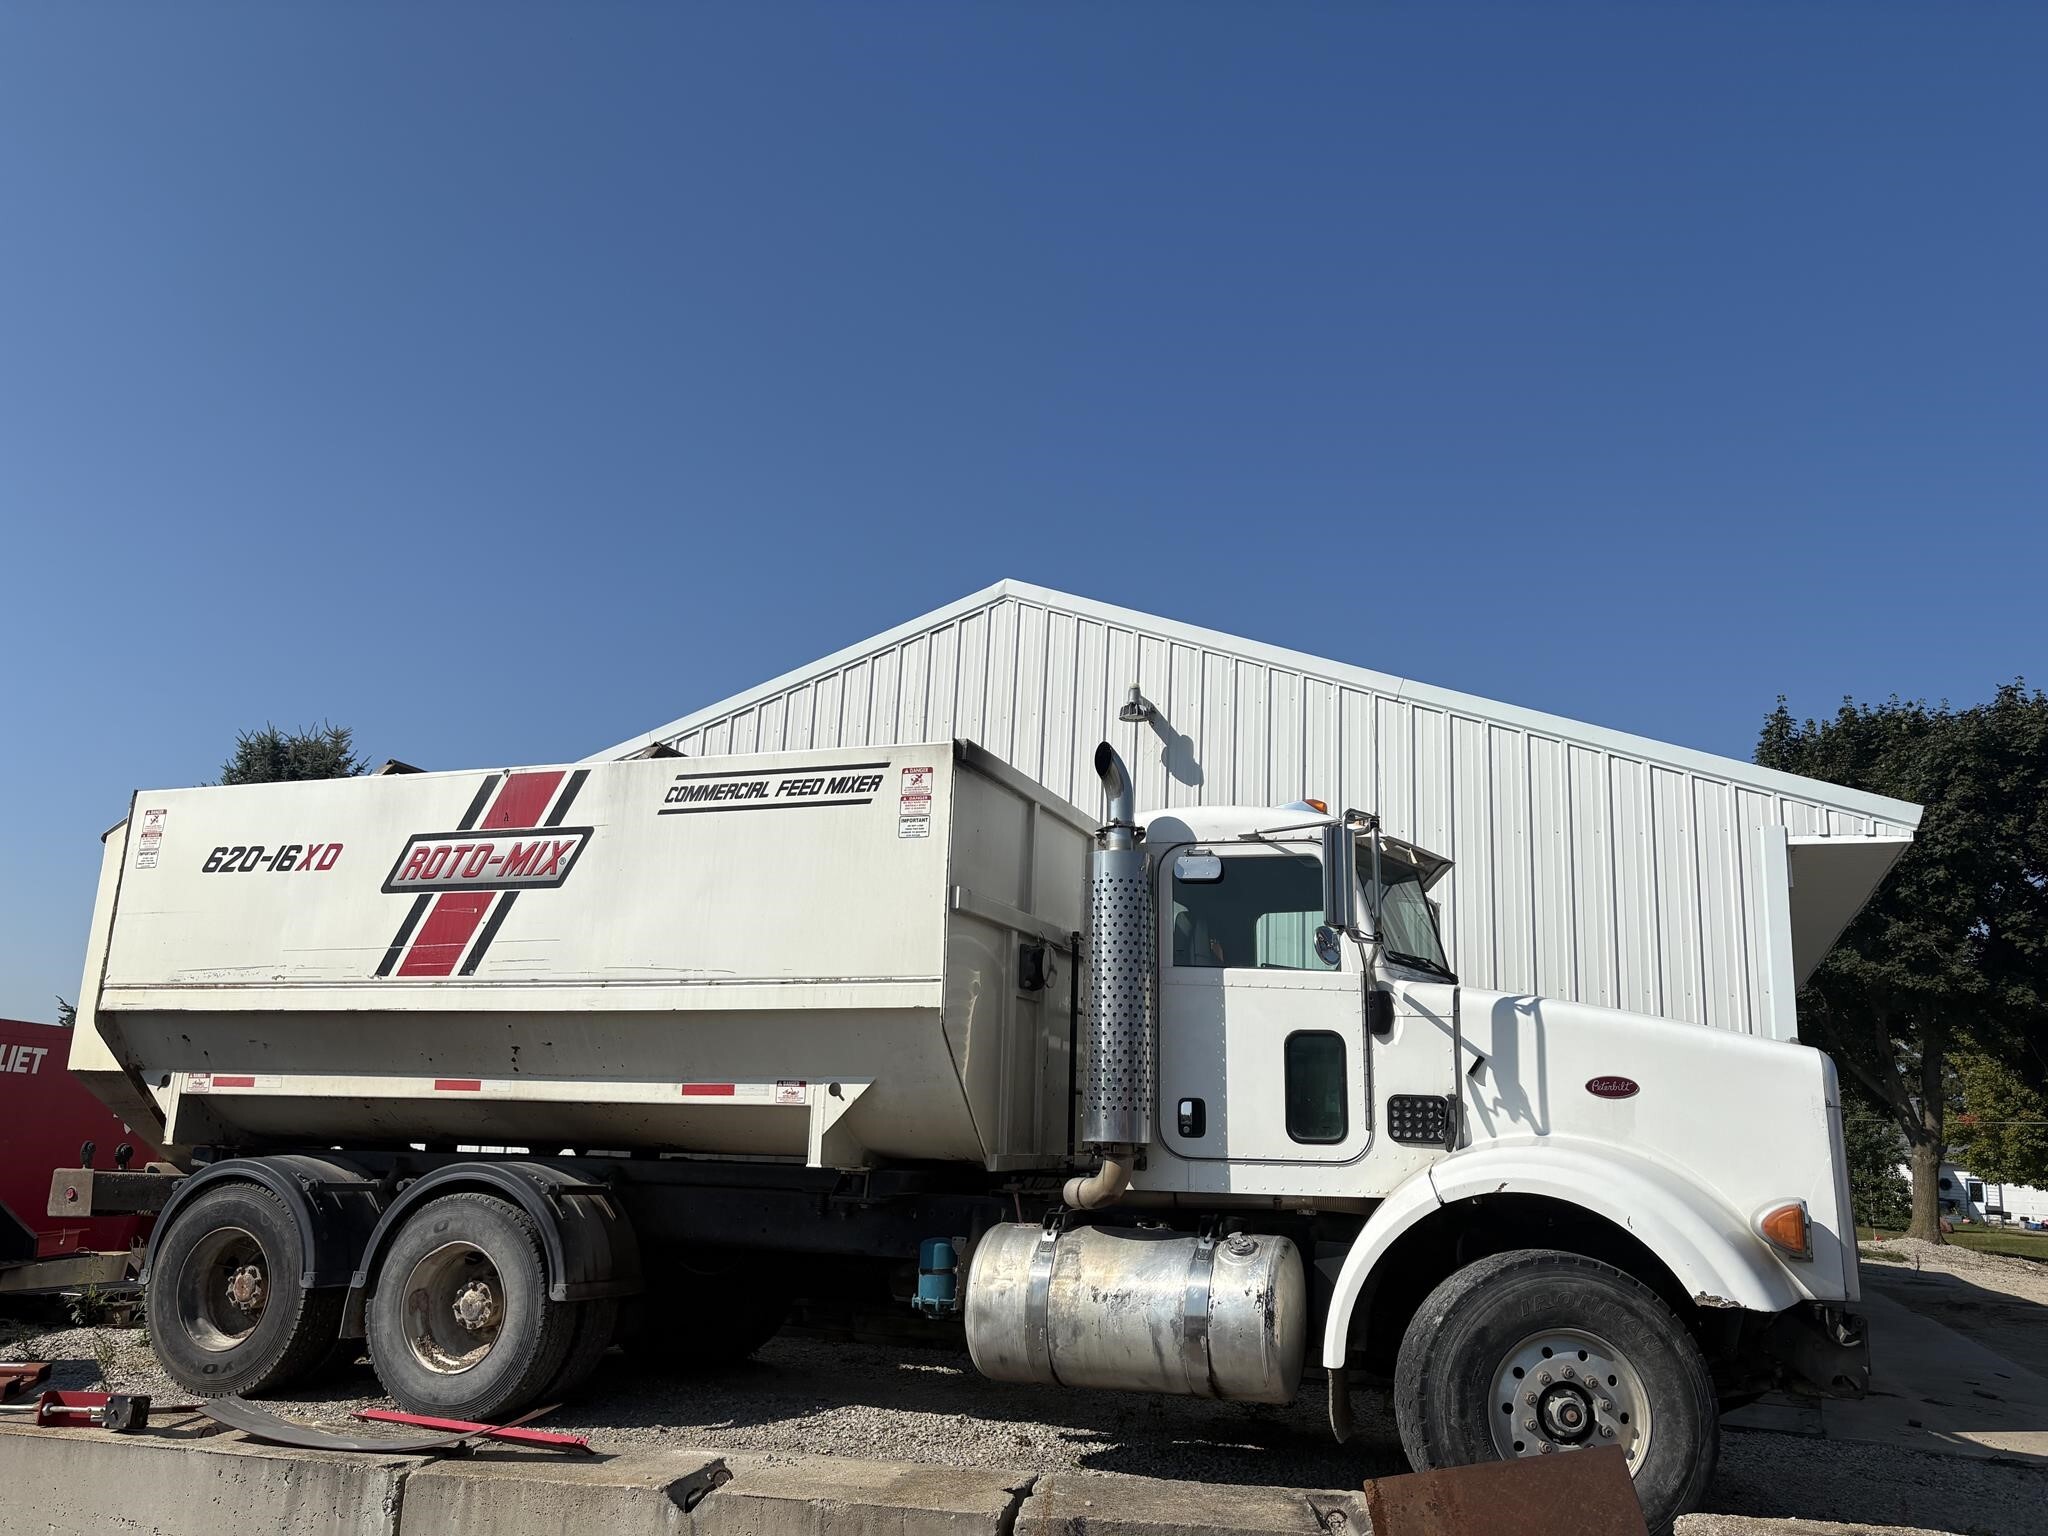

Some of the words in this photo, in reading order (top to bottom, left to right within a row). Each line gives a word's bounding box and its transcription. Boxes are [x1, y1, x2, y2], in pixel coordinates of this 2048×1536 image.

[664, 781, 770, 803] COMMERCIAL
[775, 777, 825, 797] FEED
[824, 774, 884, 795] MIXER
[201, 843, 344, 873] 620-16XD
[1591, 1079, 1633, 1092] Peterbilt
